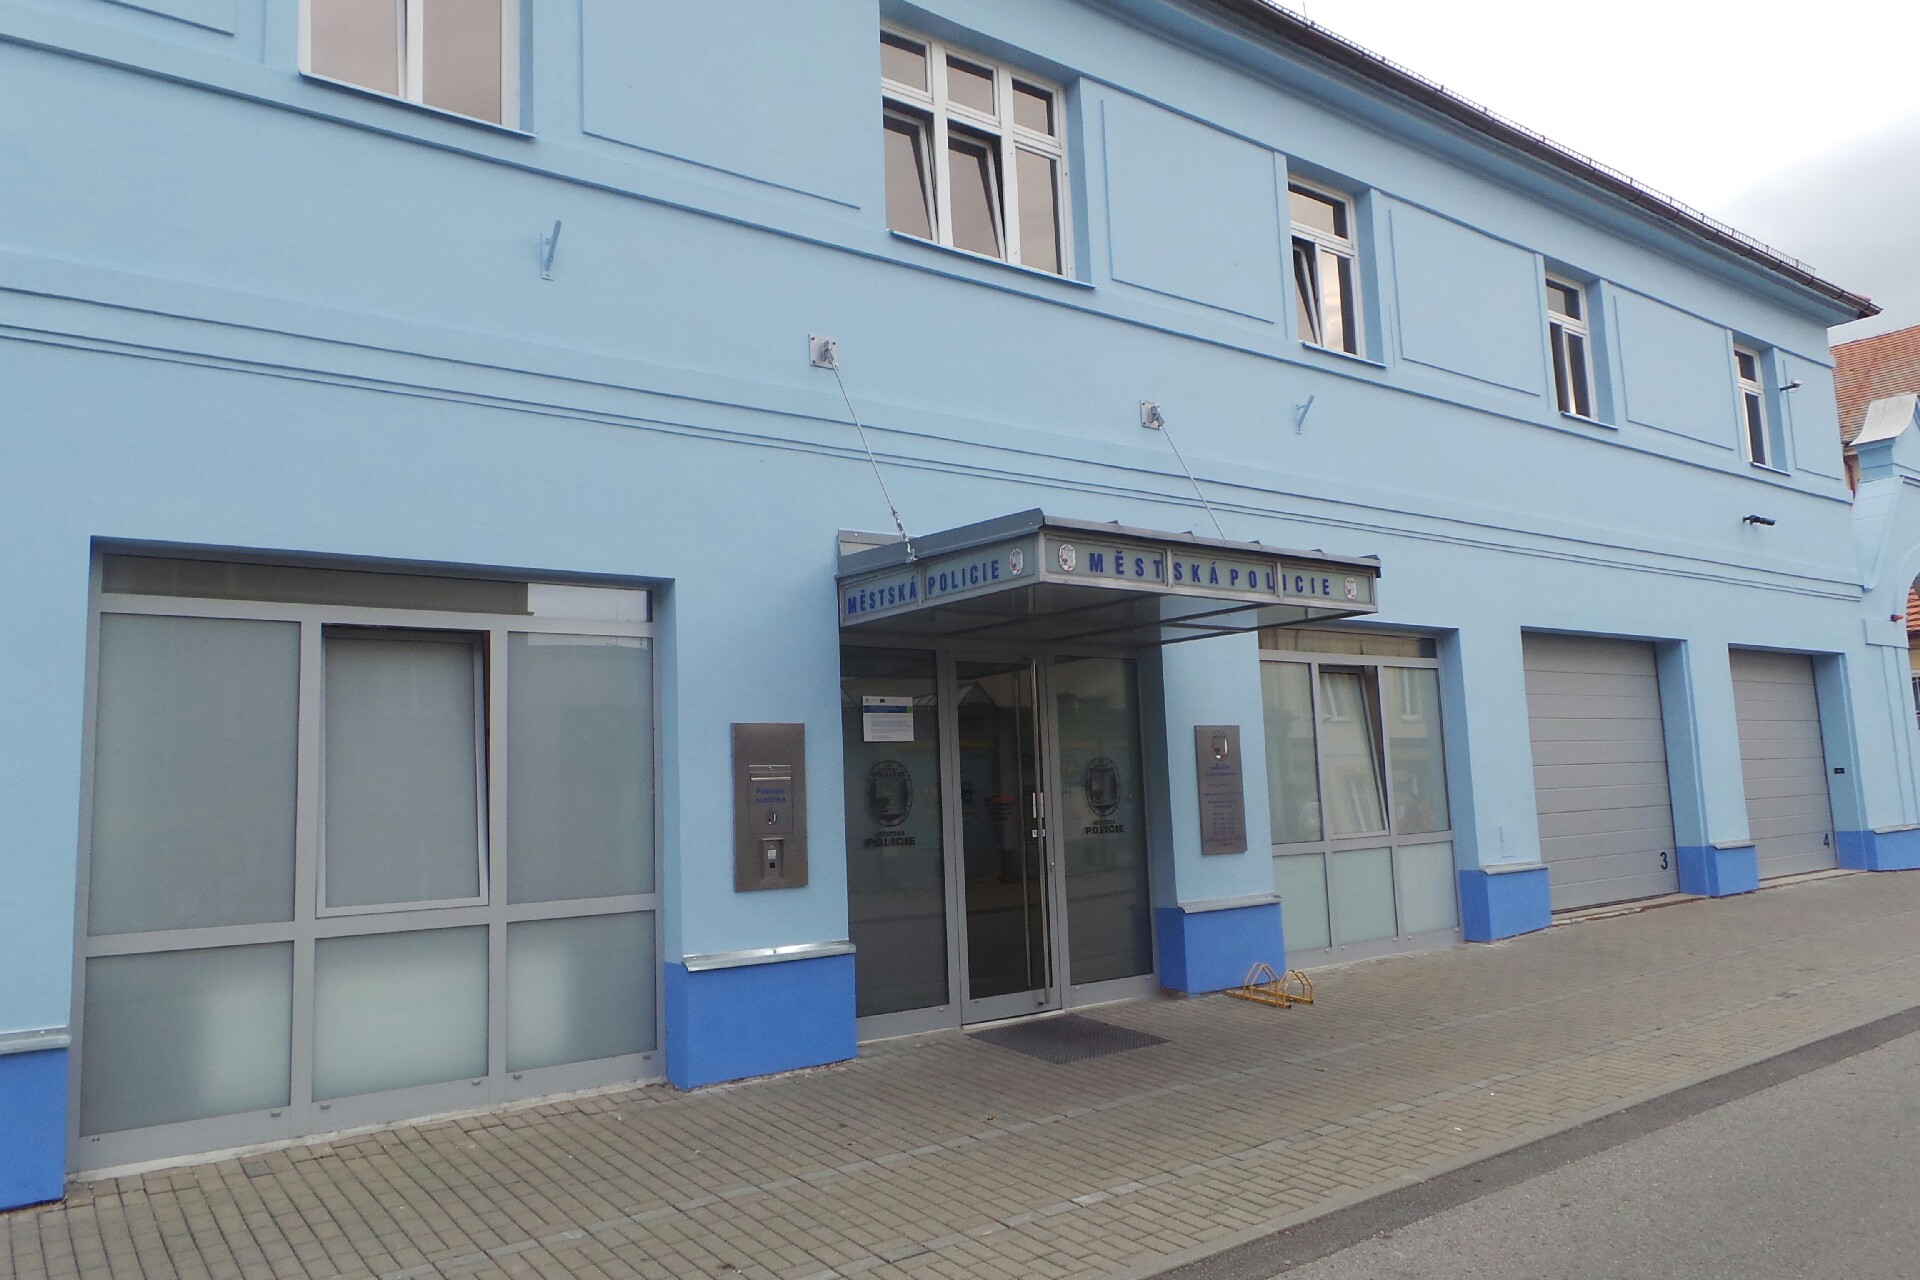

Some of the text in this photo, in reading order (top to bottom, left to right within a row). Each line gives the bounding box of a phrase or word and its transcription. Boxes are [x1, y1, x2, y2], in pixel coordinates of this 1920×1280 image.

[848, 559, 999, 615] MĚSTSKÁ POLICIE
[1229, 568, 1330, 596] POLICIE
[1085, 825, 1125, 834] POLICIE
[865, 836, 916, 847] POLICIE
[1823, 832, 1831, 849] 4
[1660, 851, 1669, 870] 3
